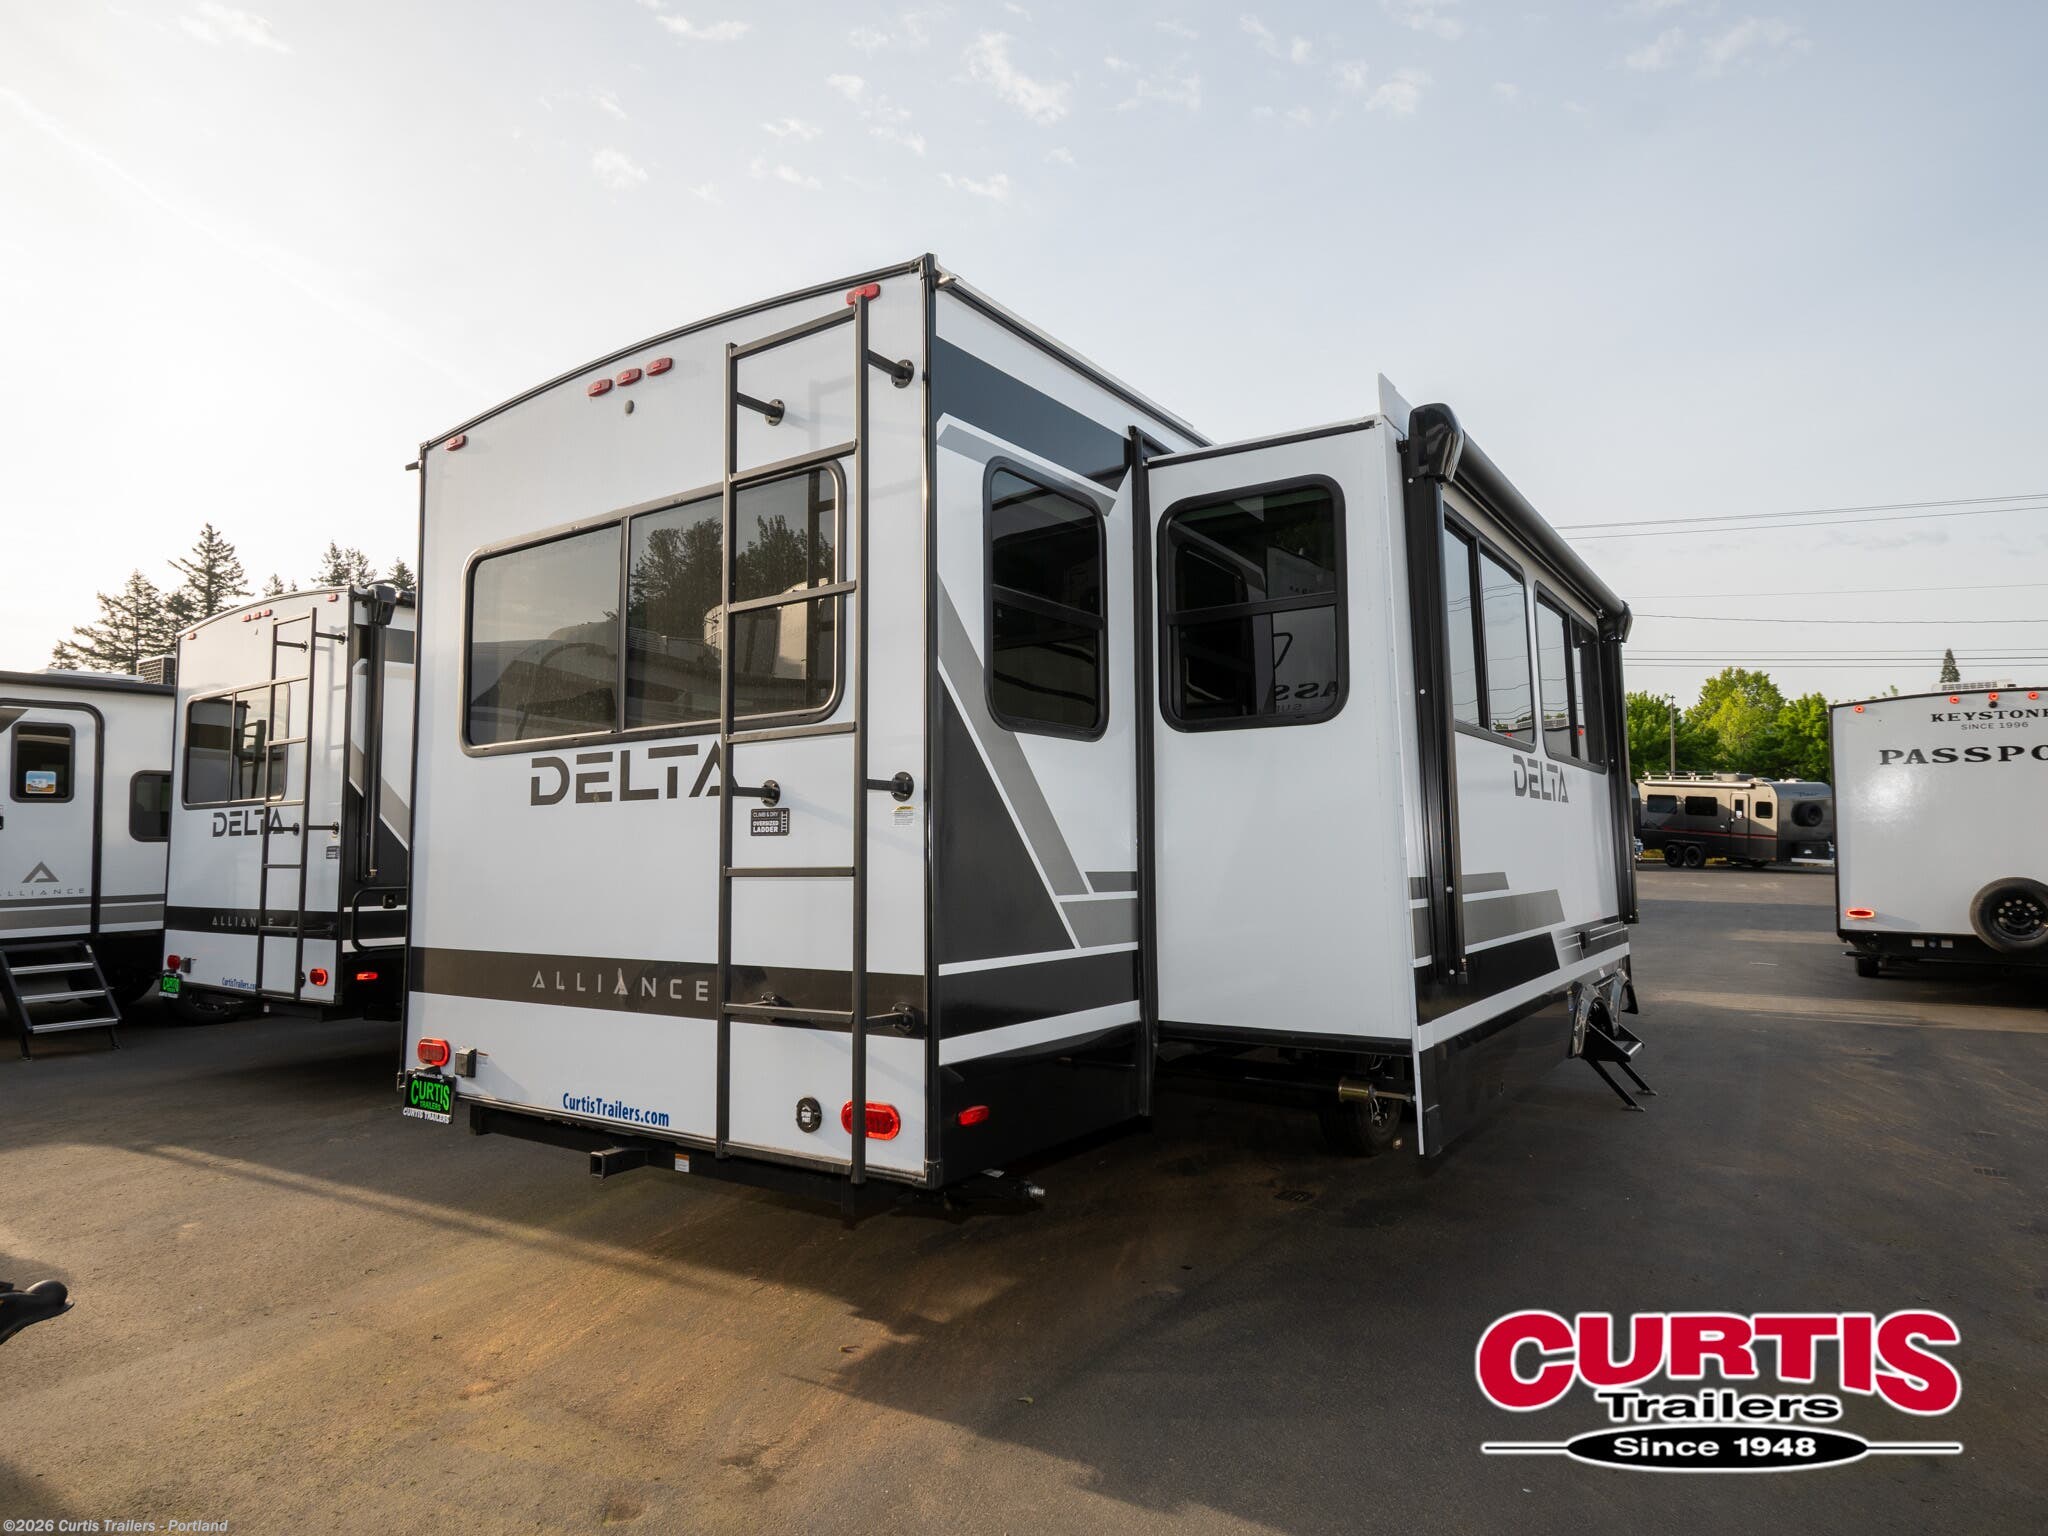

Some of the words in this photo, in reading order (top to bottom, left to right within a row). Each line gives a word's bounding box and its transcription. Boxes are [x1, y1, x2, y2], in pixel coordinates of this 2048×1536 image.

[1961, 722, 1995, 731] SINCE
[2000, 721, 2029, 729] 1996
[531, 740, 739, 806] DELTA
[1513, 753, 1569, 803] DELTA
[211, 915, 275, 928] ALLIANE
[532, 967, 709, 1002] ALLIANCE
[411, 1079, 450, 1111] CURTIS
[562, 1092, 670, 1127] CurtisTrailers.com
